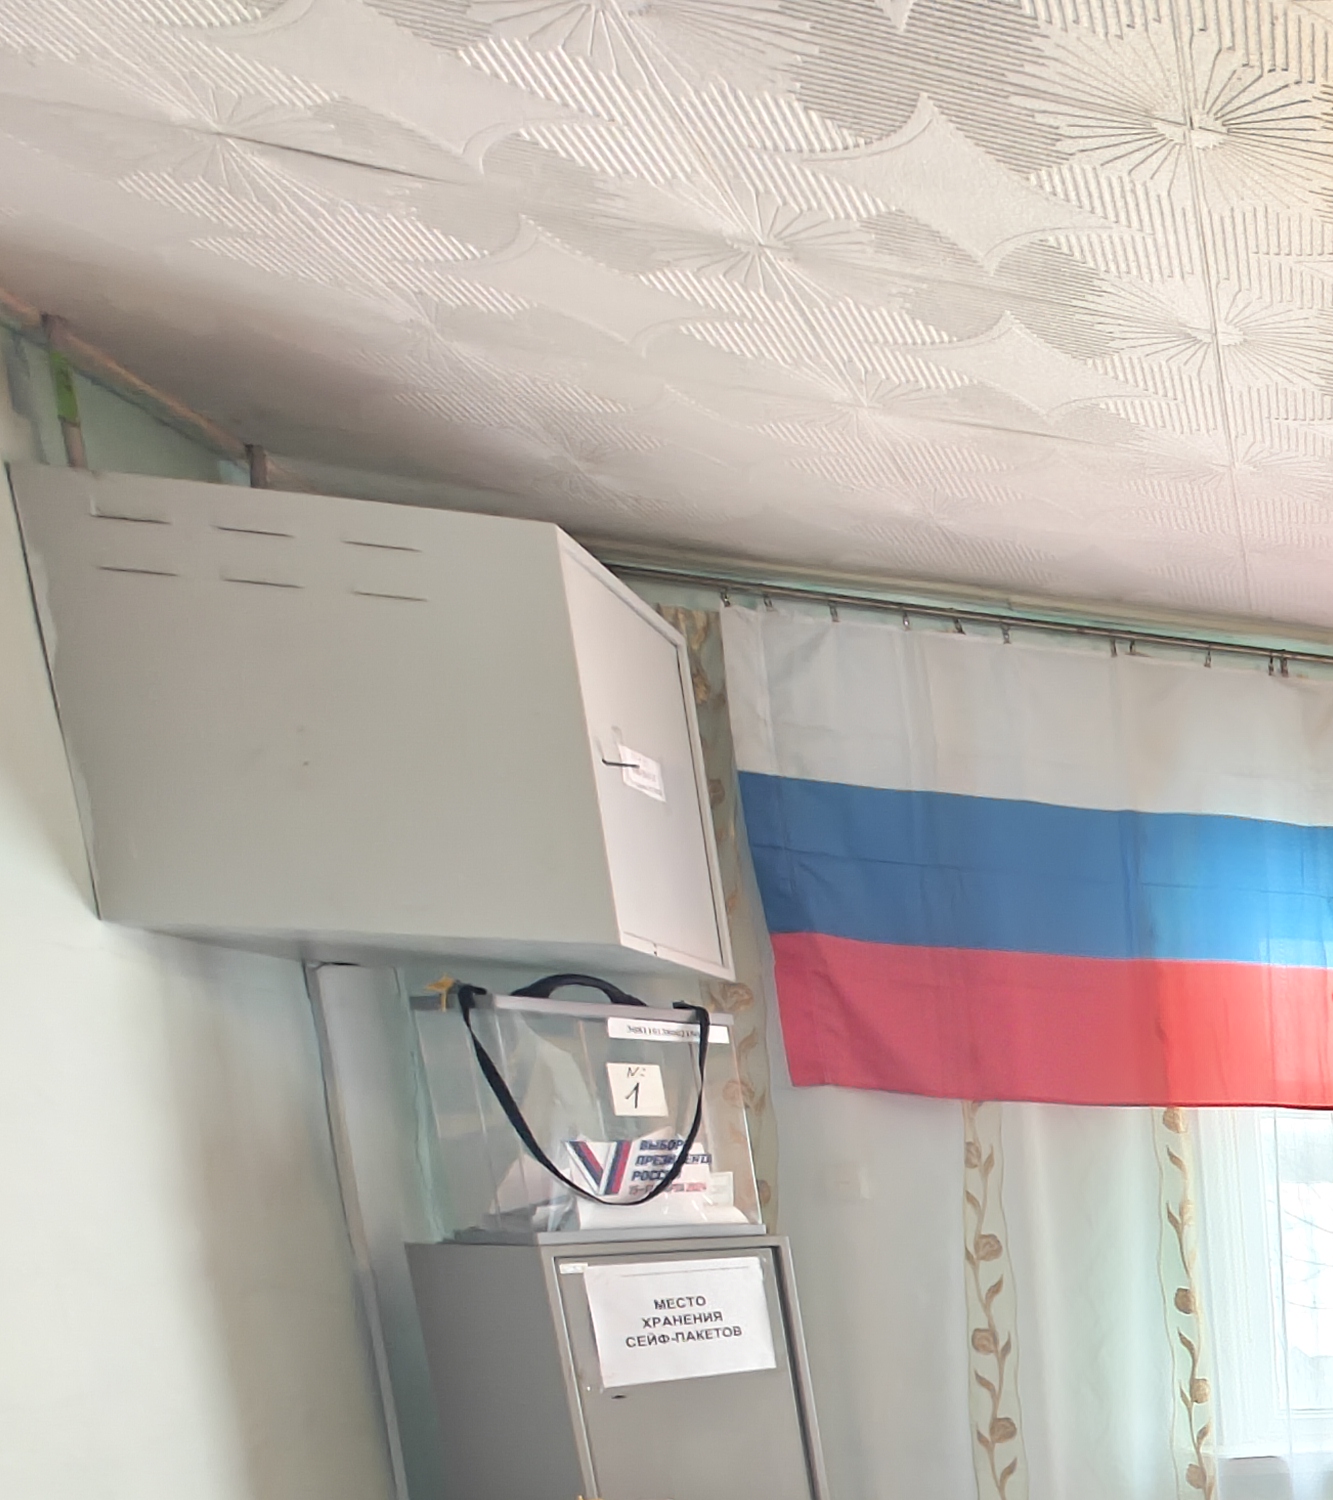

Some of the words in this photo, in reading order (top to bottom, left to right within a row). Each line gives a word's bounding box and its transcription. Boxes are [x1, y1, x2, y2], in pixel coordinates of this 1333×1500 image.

[625, 1082, 640, 1109] 1
[653, 1296, 706, 1310] МЕСТО
[642, 1311, 723, 1328] ХРАНЕНИЯ
[625, 1326, 742, 1349] СЕЙФ-ПАКЕТОВ
